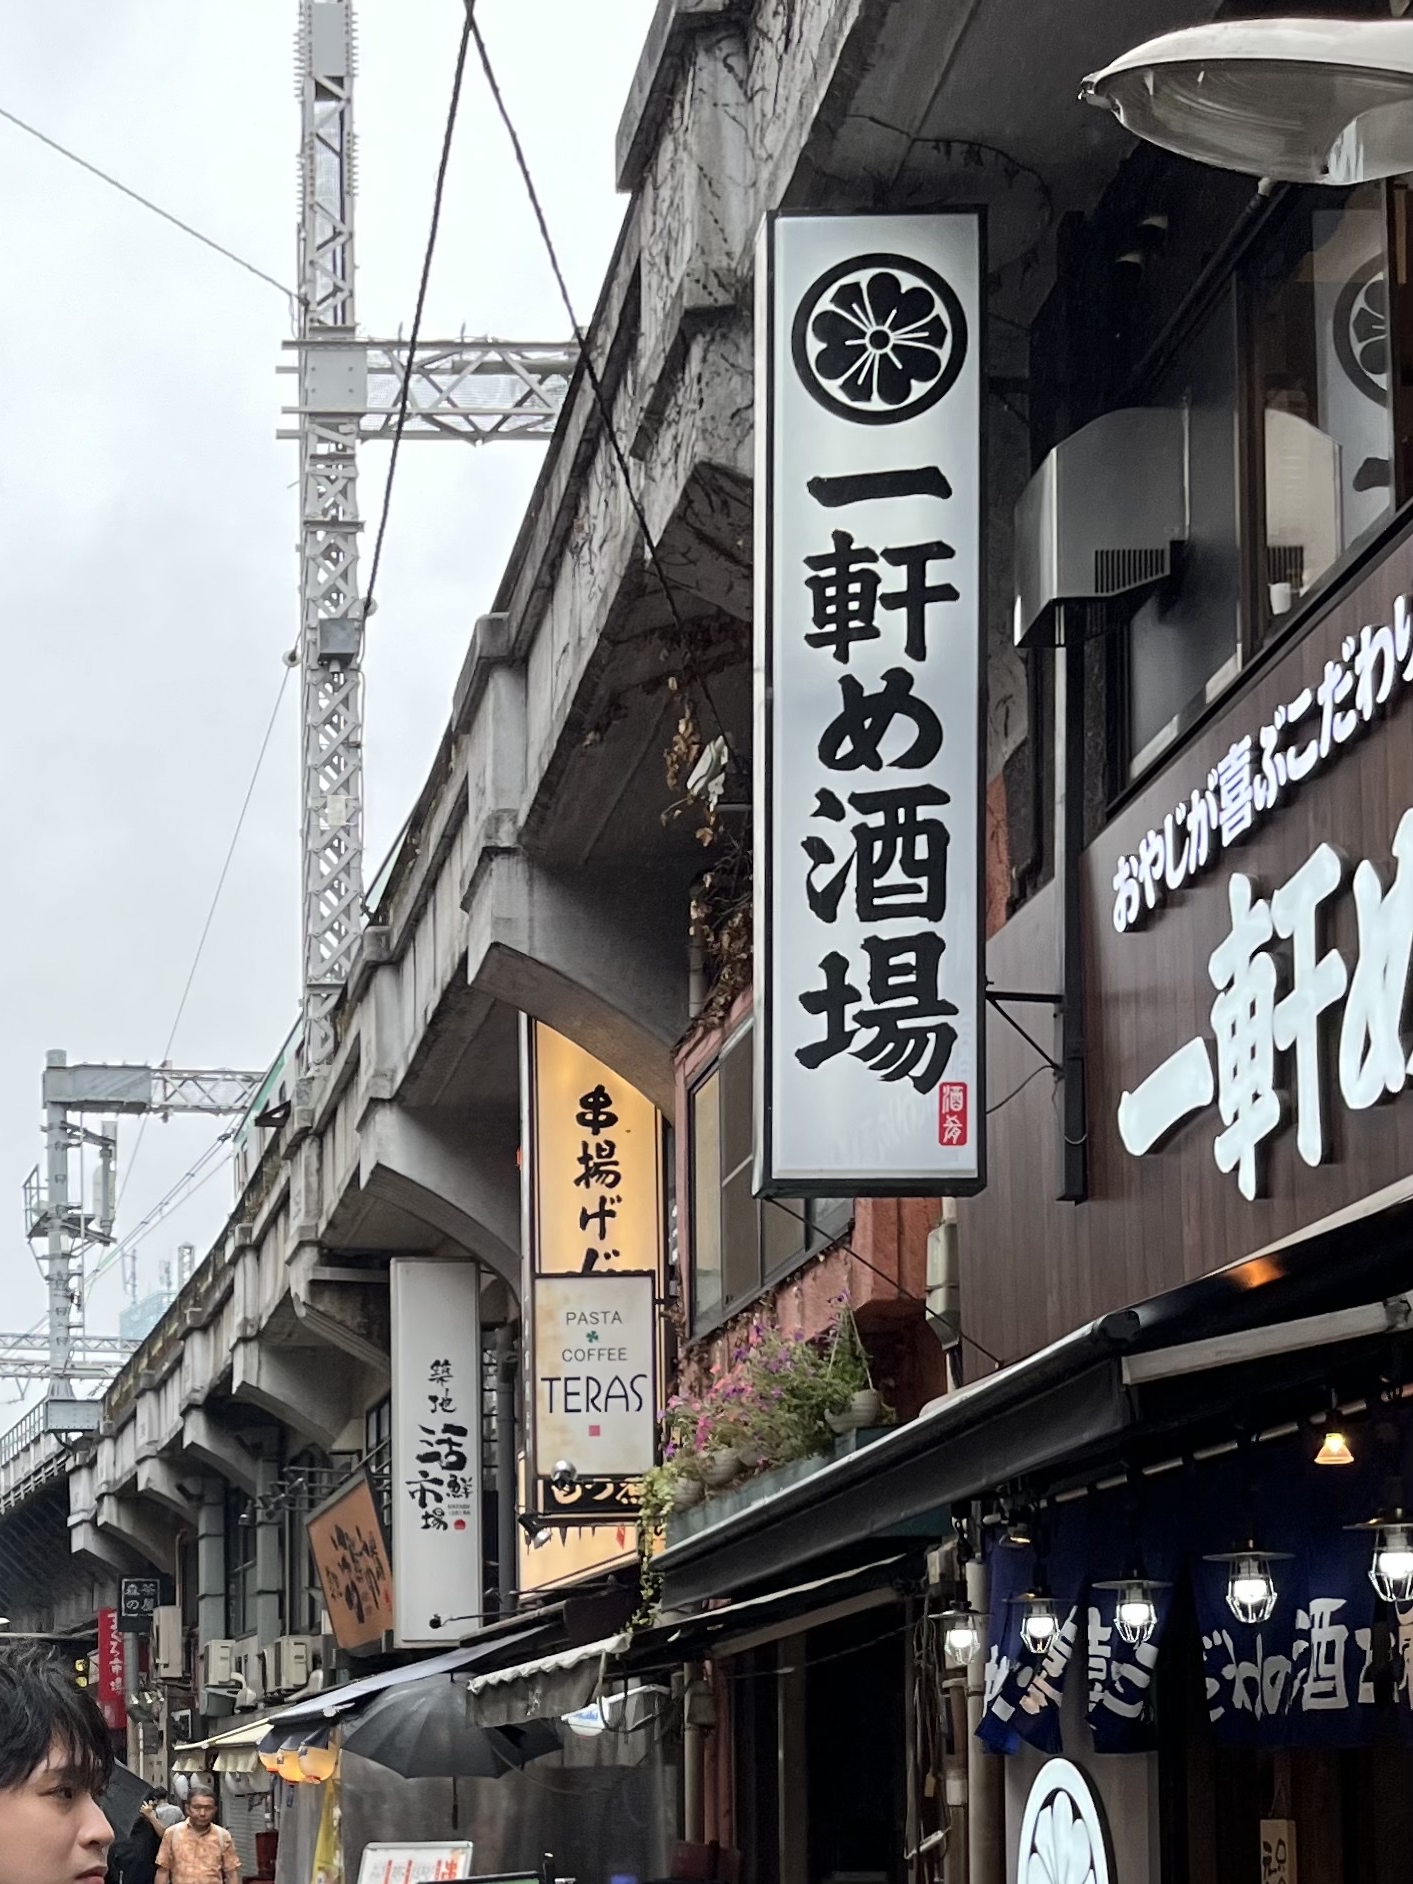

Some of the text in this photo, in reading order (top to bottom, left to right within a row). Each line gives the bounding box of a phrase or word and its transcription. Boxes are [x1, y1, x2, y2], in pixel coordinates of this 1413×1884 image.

[795, 464, 959, 1094] 一軒め酒場
[566, 1311, 622, 1325] PASTA
[562, 1348, 627, 1362] COFFEE
[541, 1374, 648, 1413] TERAS
